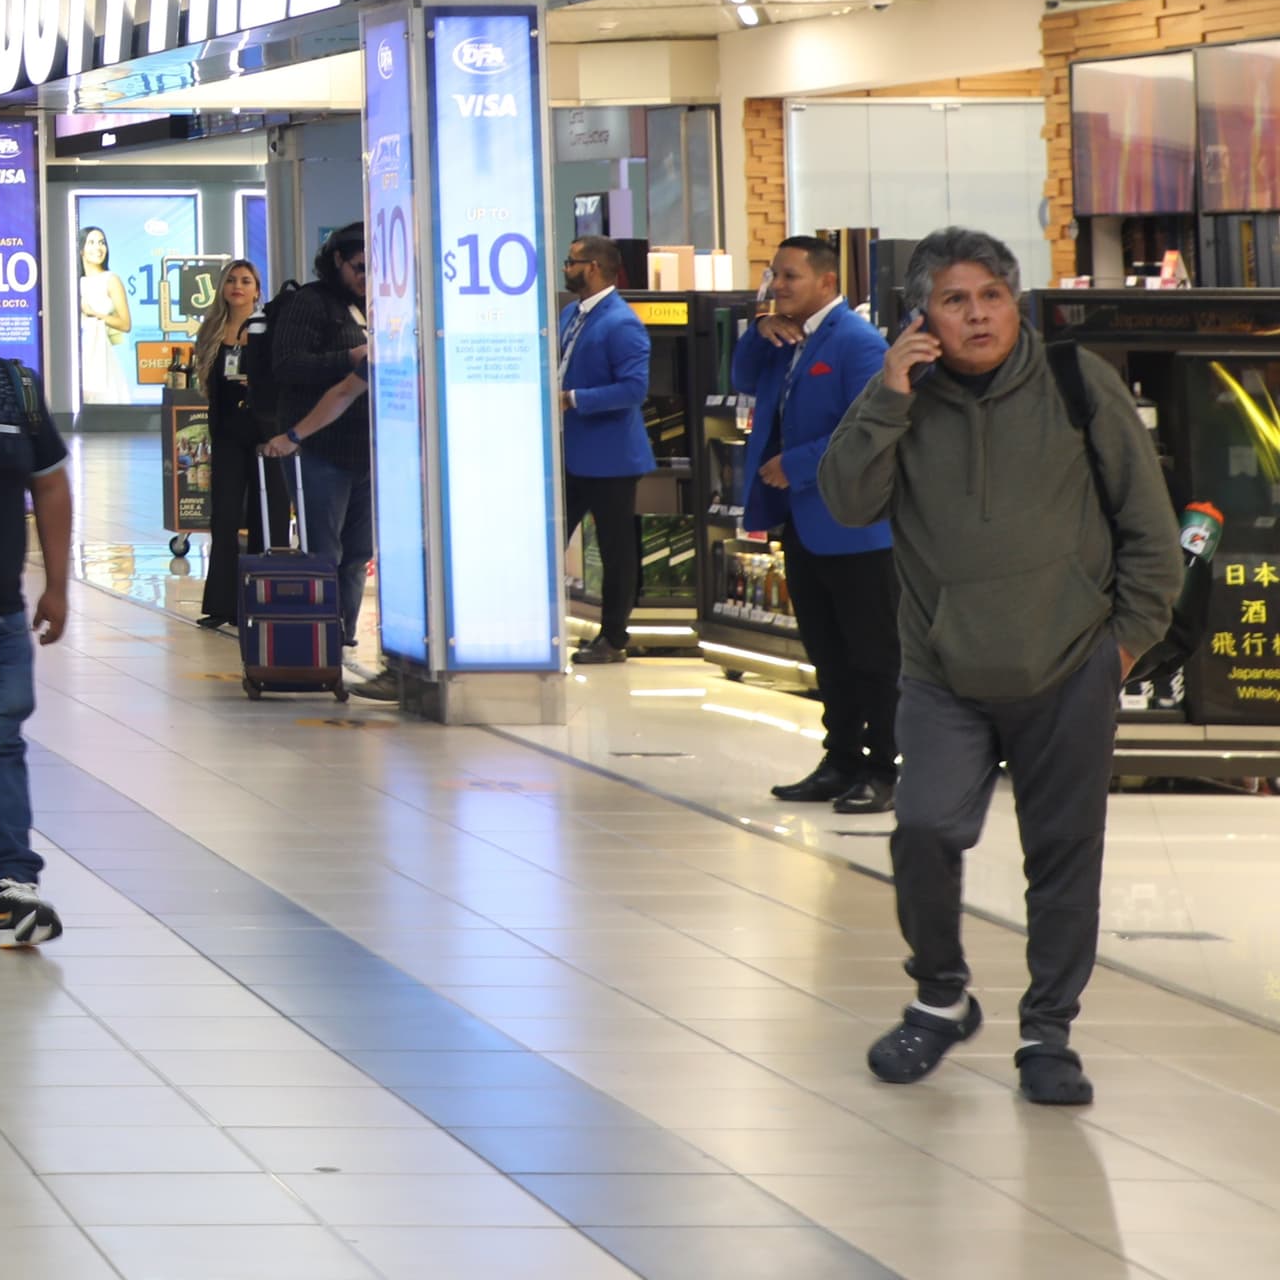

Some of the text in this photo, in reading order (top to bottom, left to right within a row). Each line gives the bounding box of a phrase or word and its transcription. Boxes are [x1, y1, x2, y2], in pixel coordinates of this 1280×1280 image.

[451, 93, 518, 118] VISA
[372, 205, 408, 298] $10
[443, 232, 538, 296] $10
[191, 272, 217, 309] J
[2, 299, 29, 308] DCTO.
[1225, 562, 1280, 587] 日本
[1240, 599, 1267, 624] 酒
